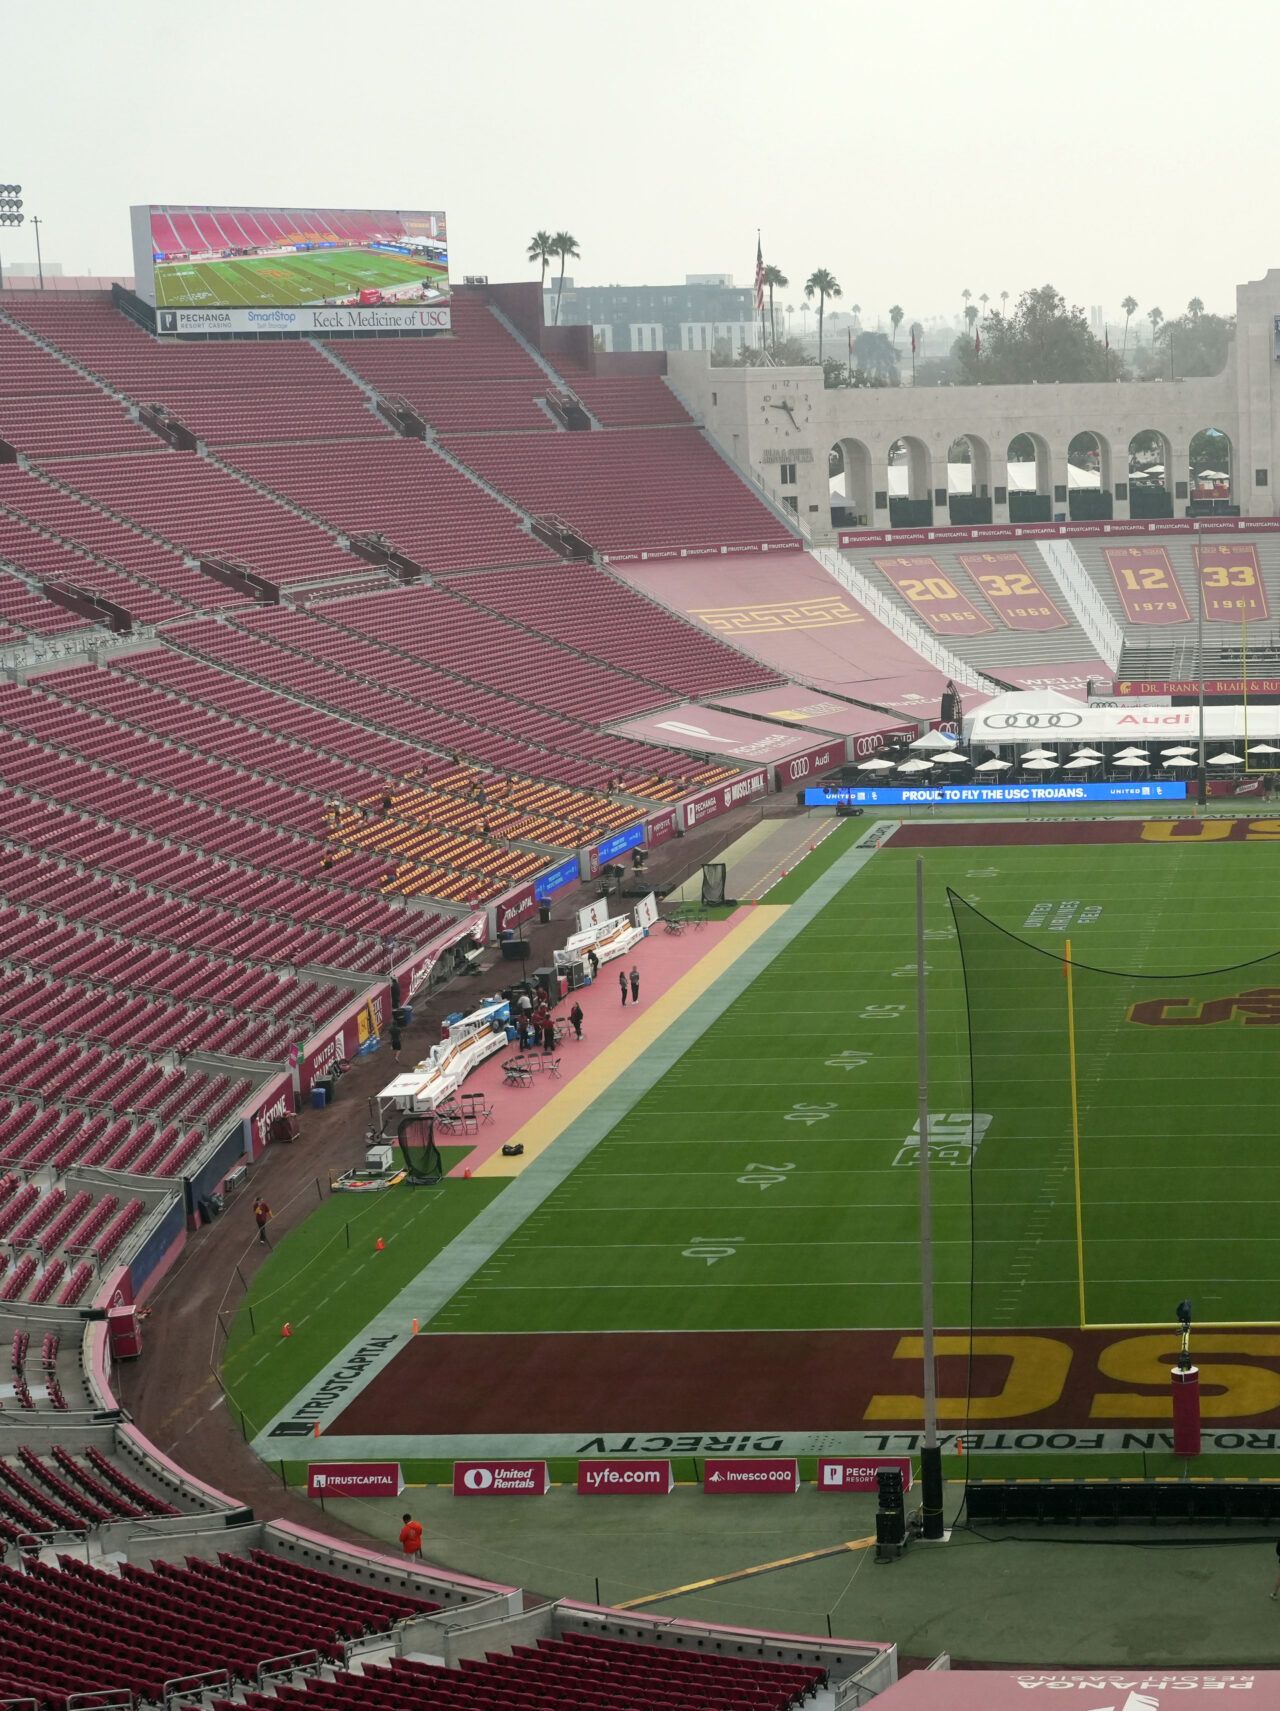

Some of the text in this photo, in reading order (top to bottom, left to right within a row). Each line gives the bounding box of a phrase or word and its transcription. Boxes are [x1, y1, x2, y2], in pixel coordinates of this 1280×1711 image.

[180, 313, 231, 322] PECHANGA
[248, 311, 296, 324] SmartStop
[313, 310, 447, 328] Keck Medicine of USC
[1120, 568, 1169, 590] 12
[1202, 566, 1255, 587] 33
[898, 578, 959, 601] 20
[978, 574, 1041, 596] 32
[1132, 600, 1178, 612] 1979
[1212, 599, 1256, 609] 1981
[928, 610, 977, 623] 1965
[1006, 607, 1052, 617] 1968
[1019, 674, 1105, 685] WELLS
[1163, 682, 1200, 692] FRANK
[1250, 681, 1259, 690] &
[1118, 714, 1191, 725] Audi
[815, 752, 830, 767] Audi
[732, 774, 764, 800] MUSCLE MILK
[945, 790, 959, 800] TO
[962, 790, 980, 800] FLY
[981, 789, 1003, 800] THE
[1005, 789, 1029, 799] USC
[1031, 788, 1088, 799] TROJANS.
[695, 797, 716, 812] PECHANGA
[1022, 903, 1052, 928] UNITED
[859, 1004, 906, 1019] 50
[313, 1042, 335, 1068] UNITED
[824, 1050, 874, 1066] 40
[783, 1102, 839, 1121] 30
[736, 1162, 797, 1184] 20
[681, 1236, 746, 1258] 10
[291, 1334, 399, 1420] ITRUSTCAPITAL
[576, 1435, 784, 1452] DIRECTV
[864, 1432, 1098, 1451] FOOTBALL
[327, 1476, 393, 1484] ITRUSTCAPITAL
[494, 1468, 533, 1479] United
[586, 1469, 660, 1486] Lyfe.com
[726, 1470, 791, 1482] Invesco QQQ
[494, 1478, 535, 1489] Rentals
[1017, 1681, 1254, 1690] PECHANGA
